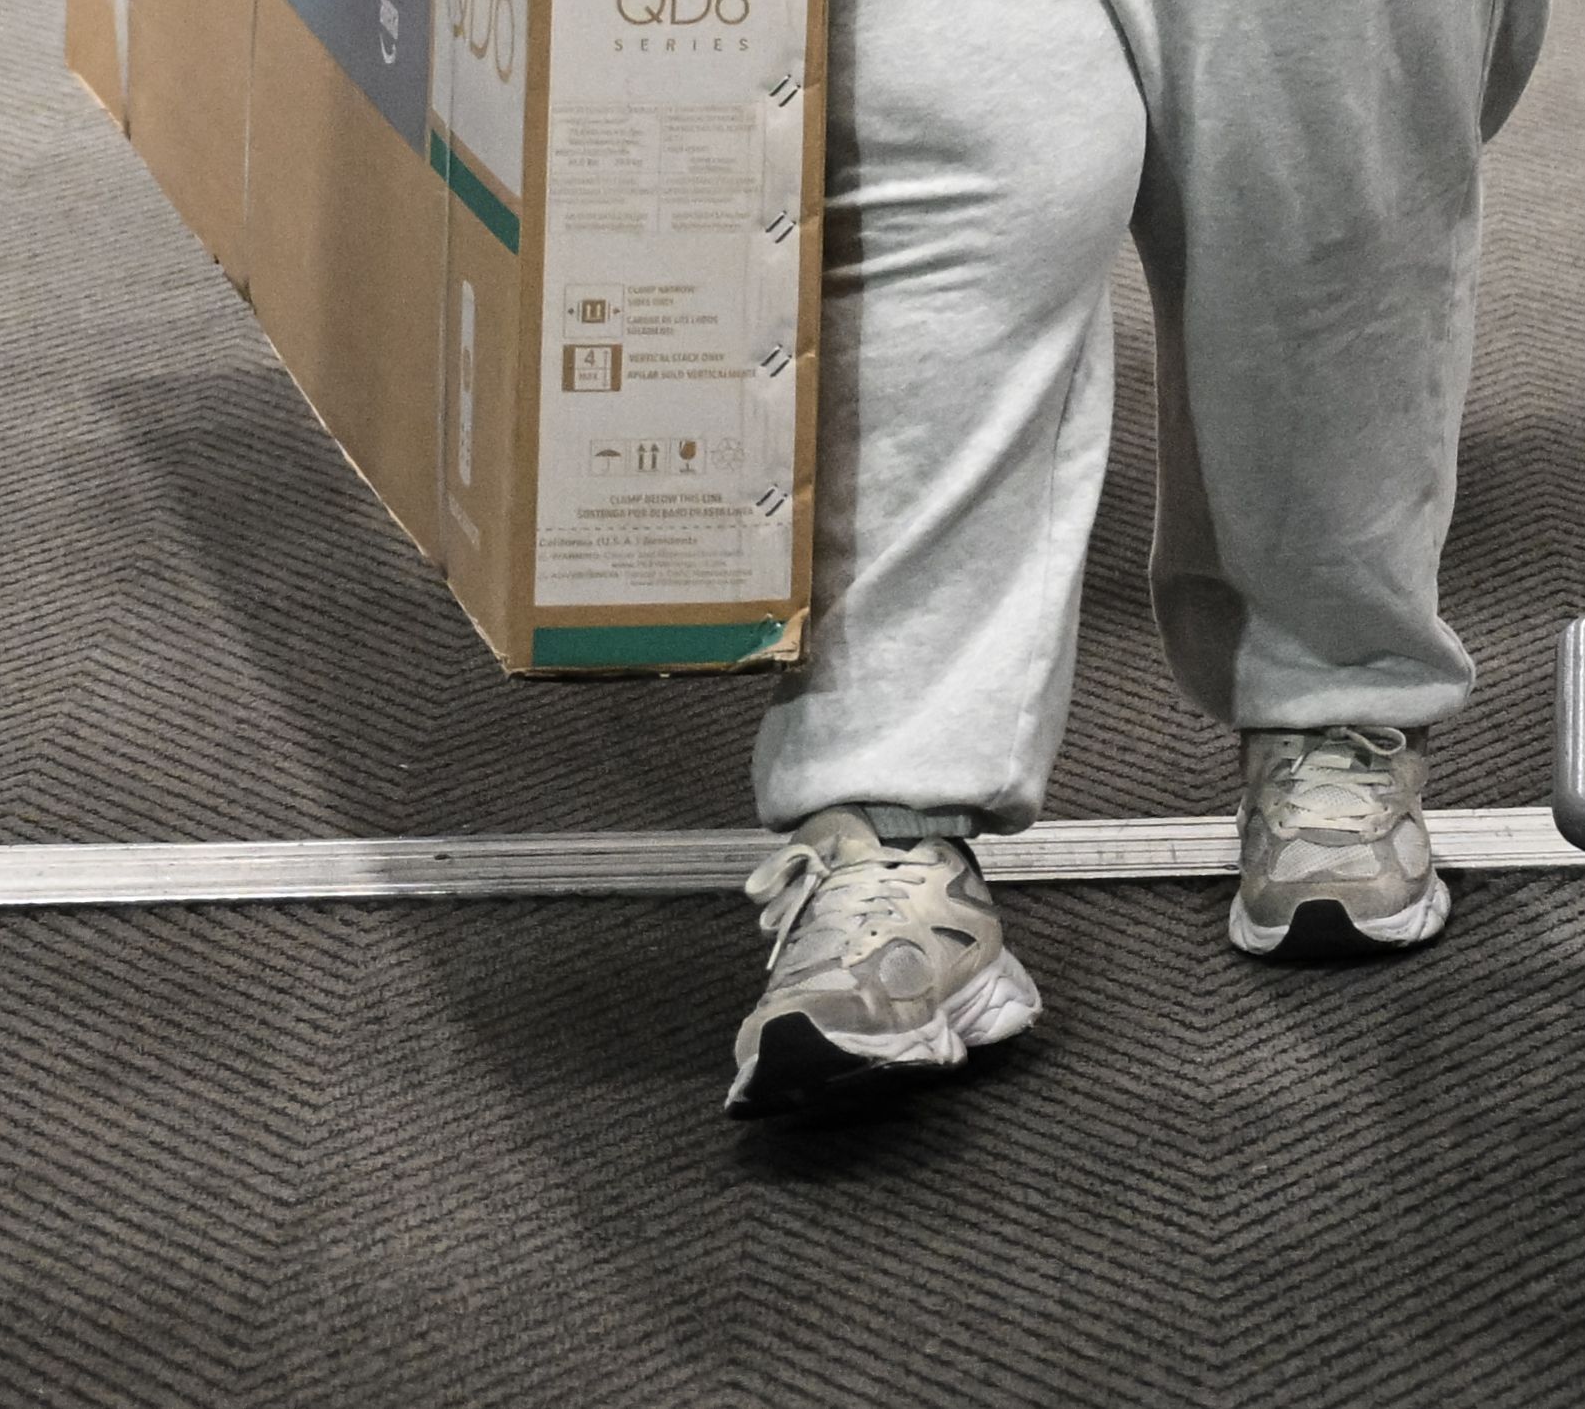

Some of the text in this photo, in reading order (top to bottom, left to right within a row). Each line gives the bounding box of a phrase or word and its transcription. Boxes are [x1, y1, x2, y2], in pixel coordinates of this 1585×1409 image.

[614, 38, 749, 52] SERIES
[583, 350, 596, 367] 4
[629, 353, 725, 363] VERTICAL STACK ONLY
[609, 493, 722, 504] CLAMP BELOW THIS LINE
